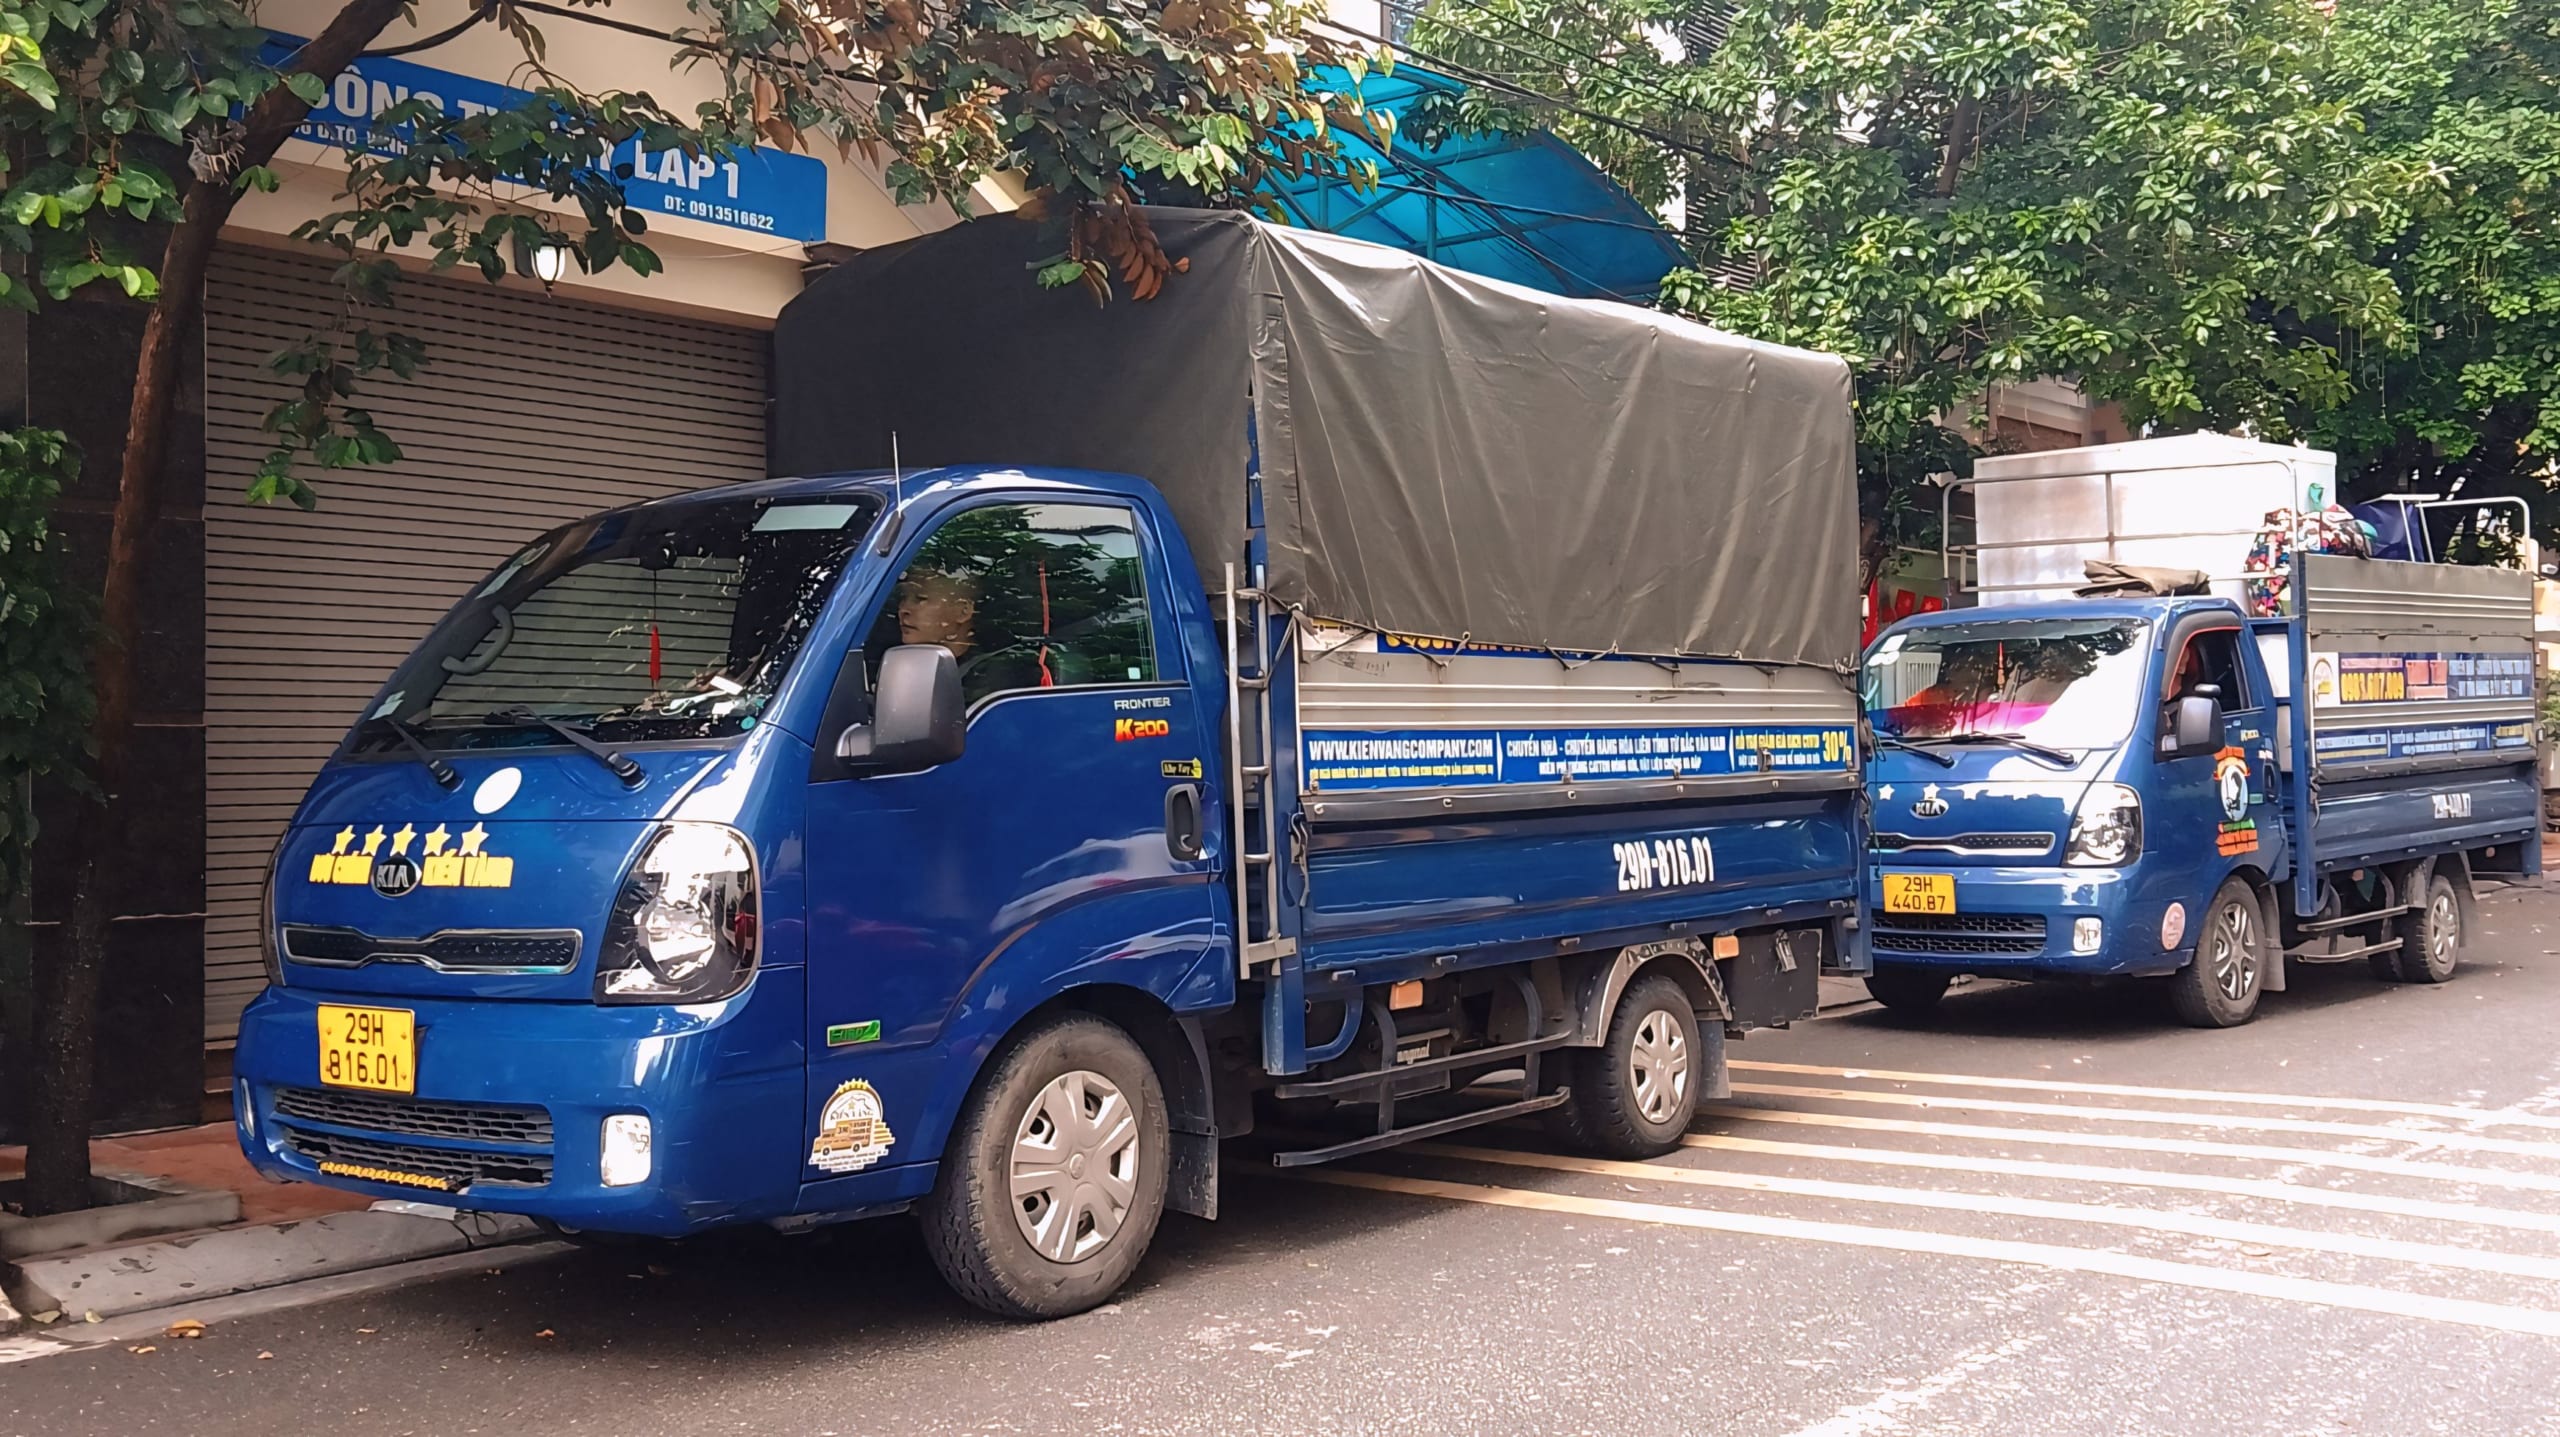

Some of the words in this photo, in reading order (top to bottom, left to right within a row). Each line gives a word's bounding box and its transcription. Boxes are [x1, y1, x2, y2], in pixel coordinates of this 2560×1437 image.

[1114, 697, 1171, 710] FRONTIER
[1115, 718, 1169, 742] K200
[1309, 738, 1493, 761] WWW.KIENVANGCOMPANY.COM
[1822, 730, 1852, 762] 30%
[1915, 802, 1942, 815] KIA
[1613, 836, 1714, 891] 29H-816.01
[376, 864, 410, 888] KIA
[1903, 877, 1934, 893] 29H
[1893, 895, 1946, 911] 440.87
[345, 1012, 384, 1047] 29H
[329, 1049, 398, 1088] 816.01
